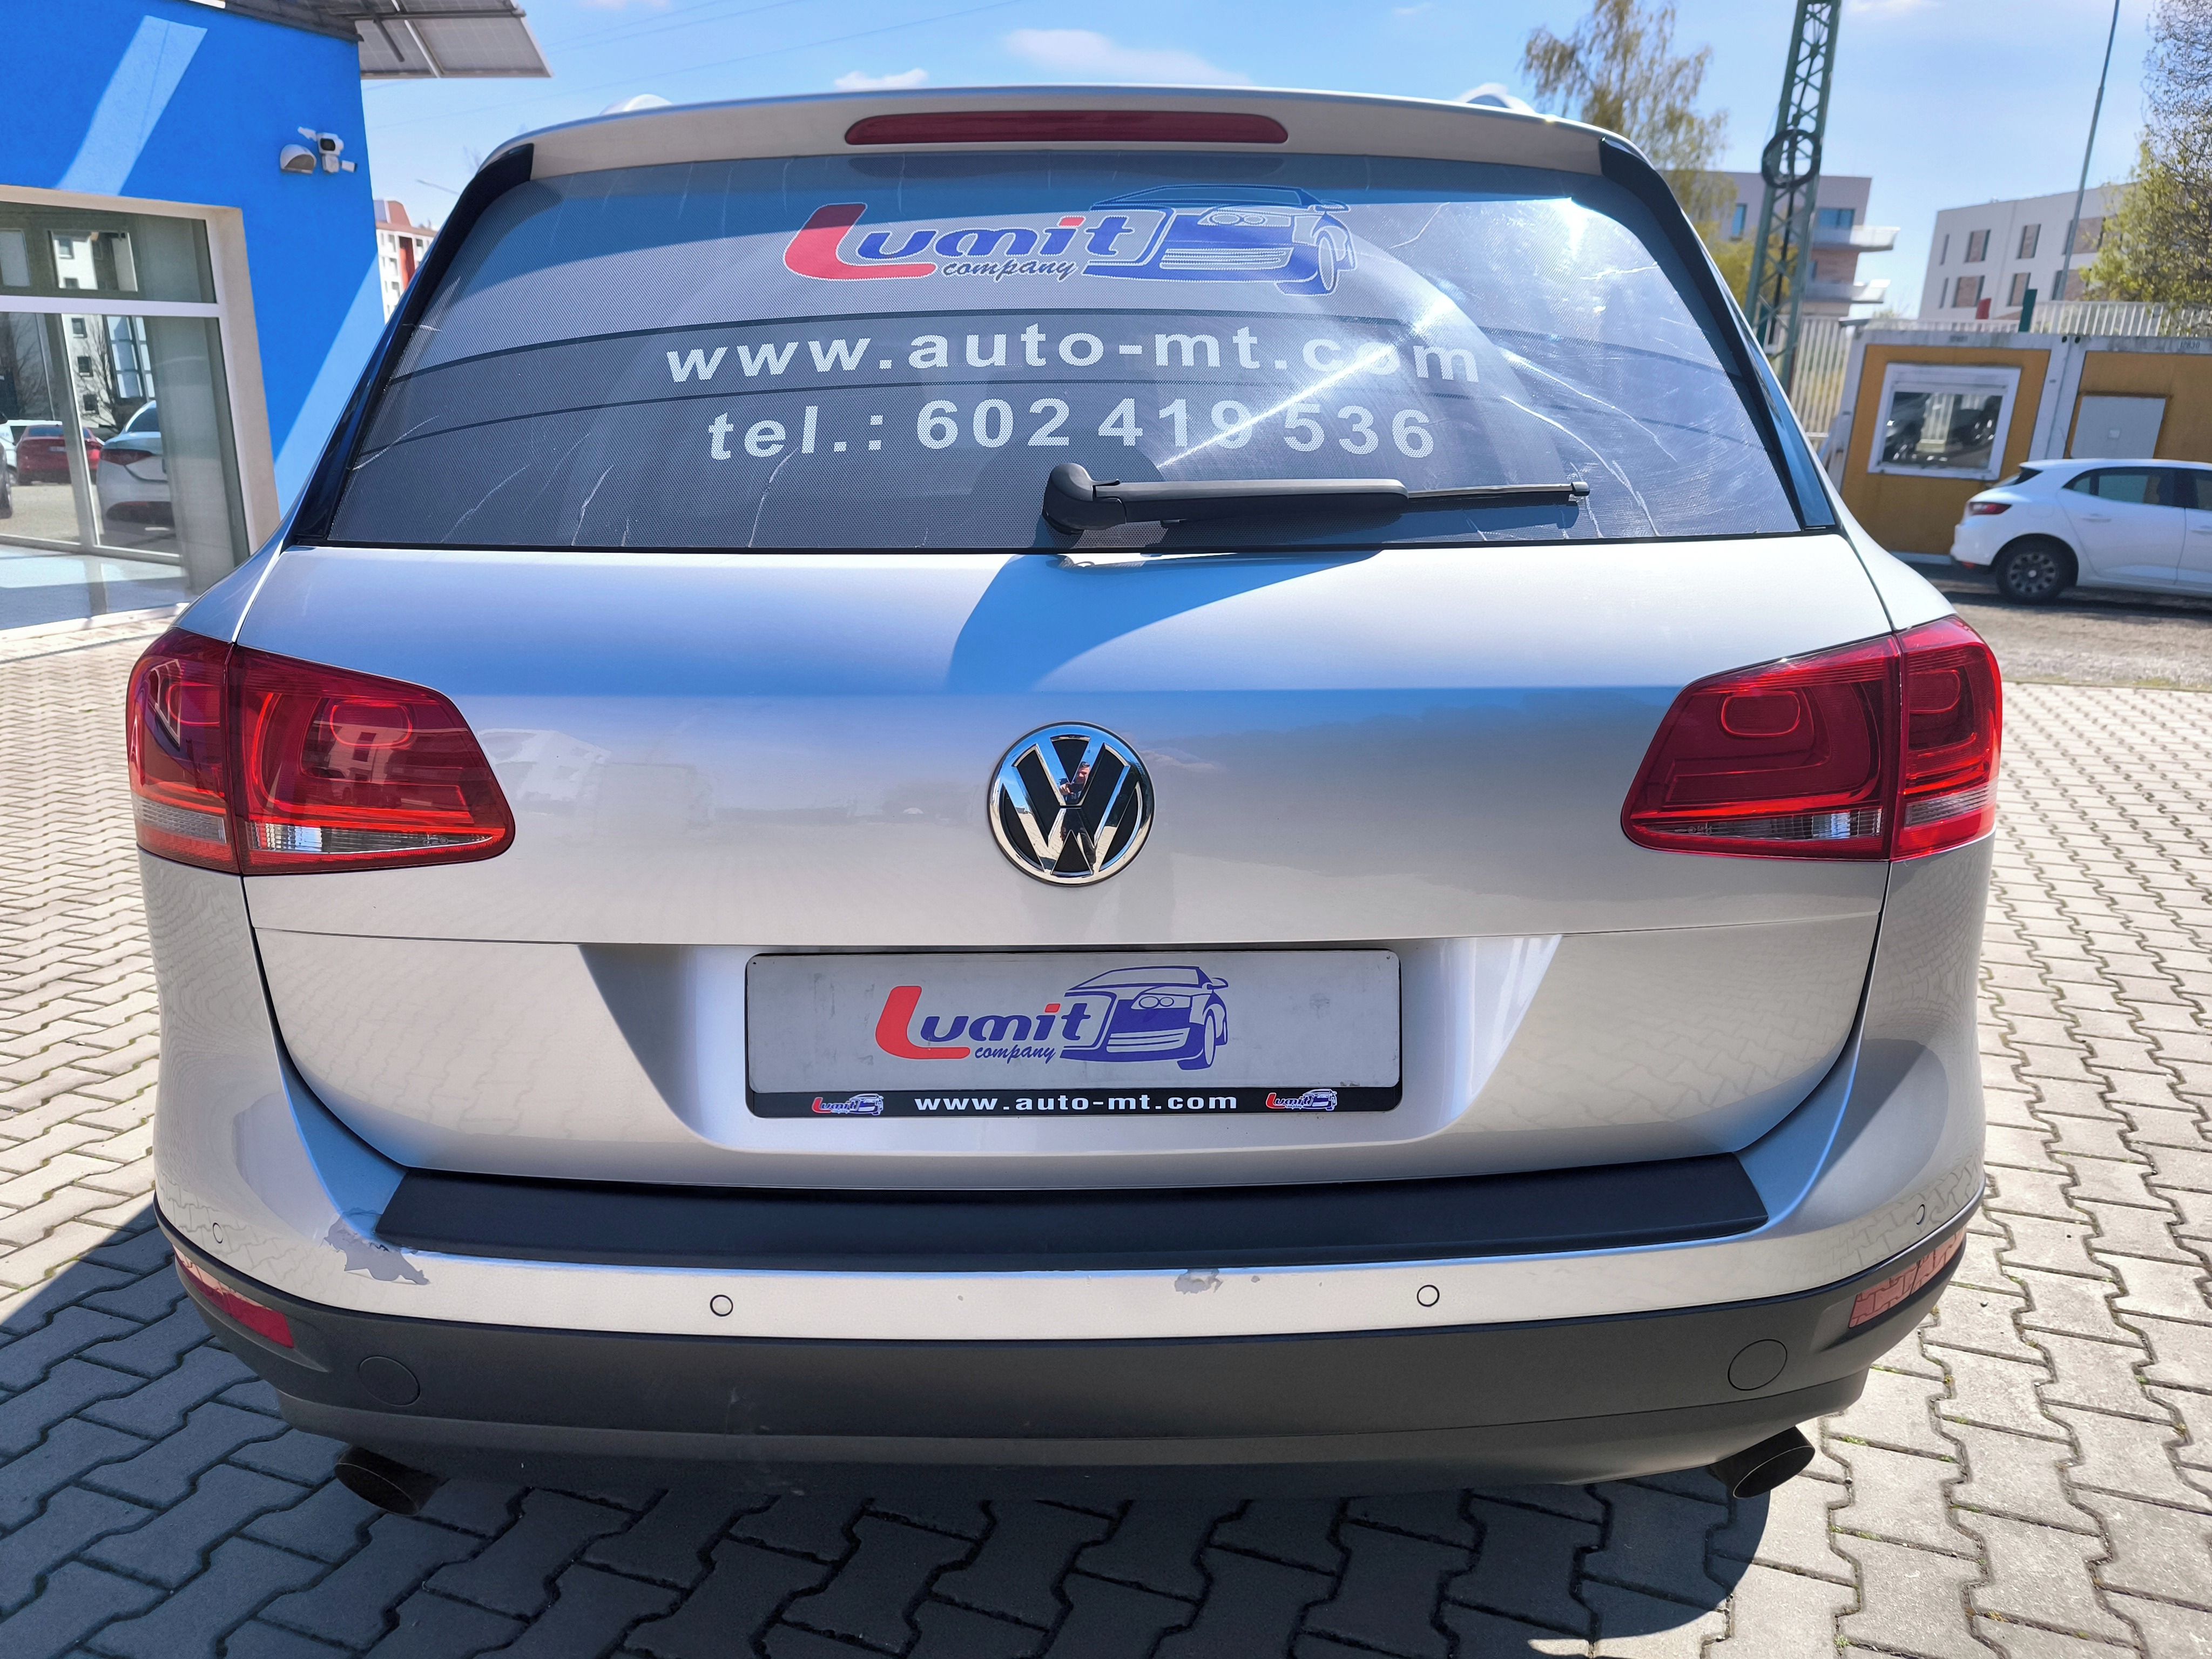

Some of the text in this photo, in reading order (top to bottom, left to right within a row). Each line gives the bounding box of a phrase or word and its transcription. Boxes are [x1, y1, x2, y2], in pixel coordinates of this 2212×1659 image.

[784, 203, 1133, 280] Lumit
[942, 259, 1078, 281] company
[665, 323, 1478, 382] www.auto-mt.com
[708, 398, 1435, 460] tel.: 602 419 536
[875, 986, 1091, 1060] Lumit
[974, 1044, 1057, 1063] company
[812, 1097, 856, 1113] Lumit
[914, 1095, 1237, 1111] www.auto-mt.com
[1266, 1092, 1310, 1108] Lumit
